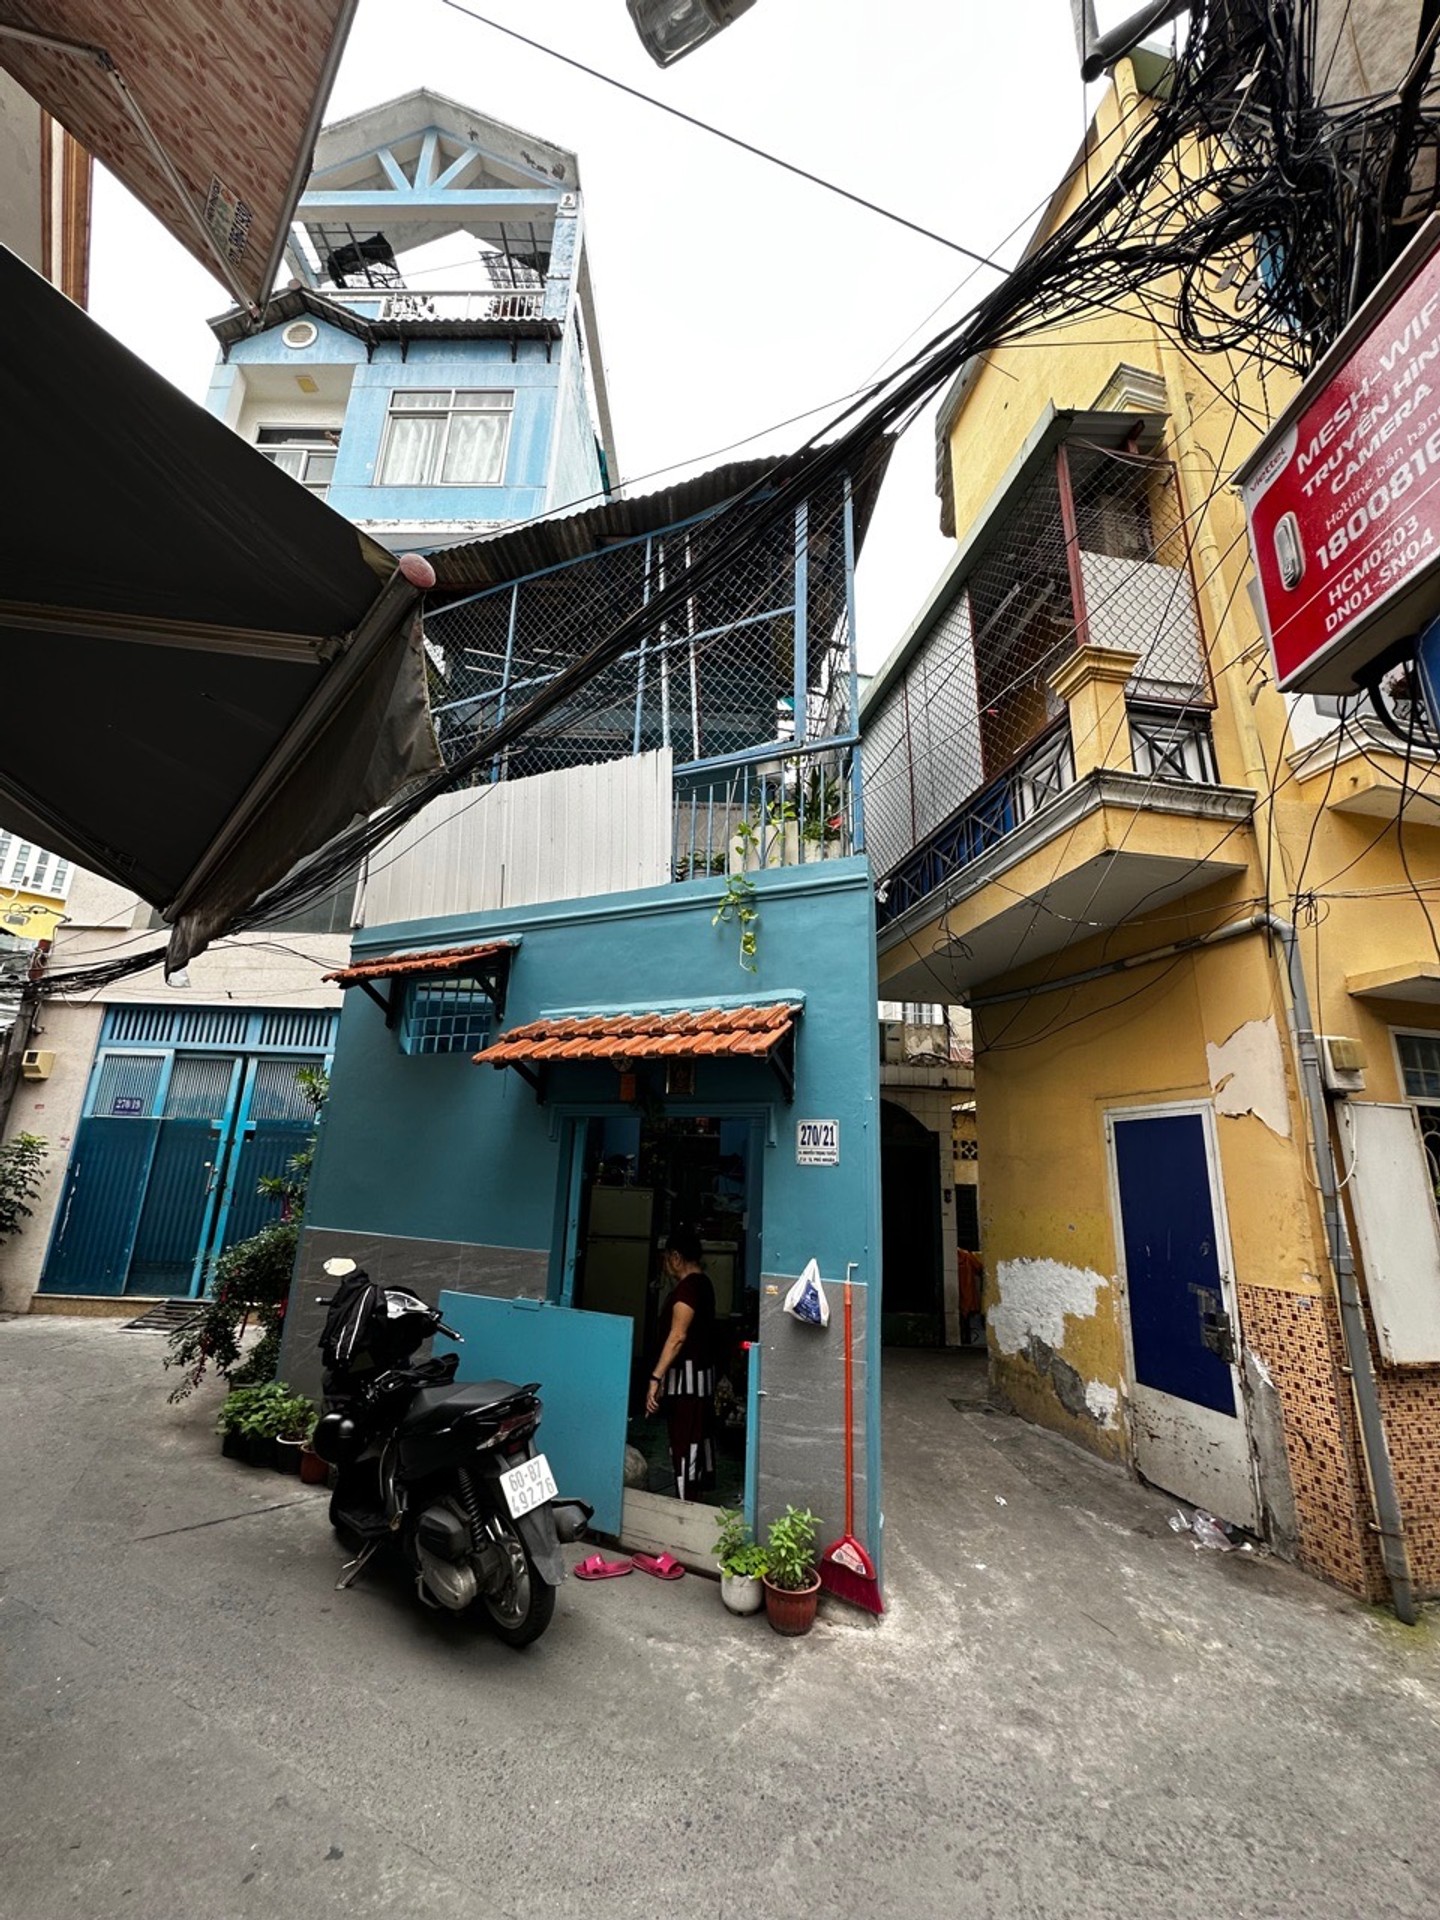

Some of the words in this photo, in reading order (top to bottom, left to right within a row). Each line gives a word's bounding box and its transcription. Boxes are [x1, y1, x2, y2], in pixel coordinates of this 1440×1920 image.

[1302, 393, 1389, 497] TRUYỀN
[1392, 334, 1440, 399] HÌN
[1331, 383, 1434, 494] CAMERA
[1325, 478, 1374, 531] Hotline
[1376, 446, 1404, 478] bán
[1325, 527, 1434, 632] DN01-SN04
[1328, 515, 1419, 607] HCM0203
[800, 1124, 835, 1147] 270/21
[511, 1477, 555, 1513] 492.76
